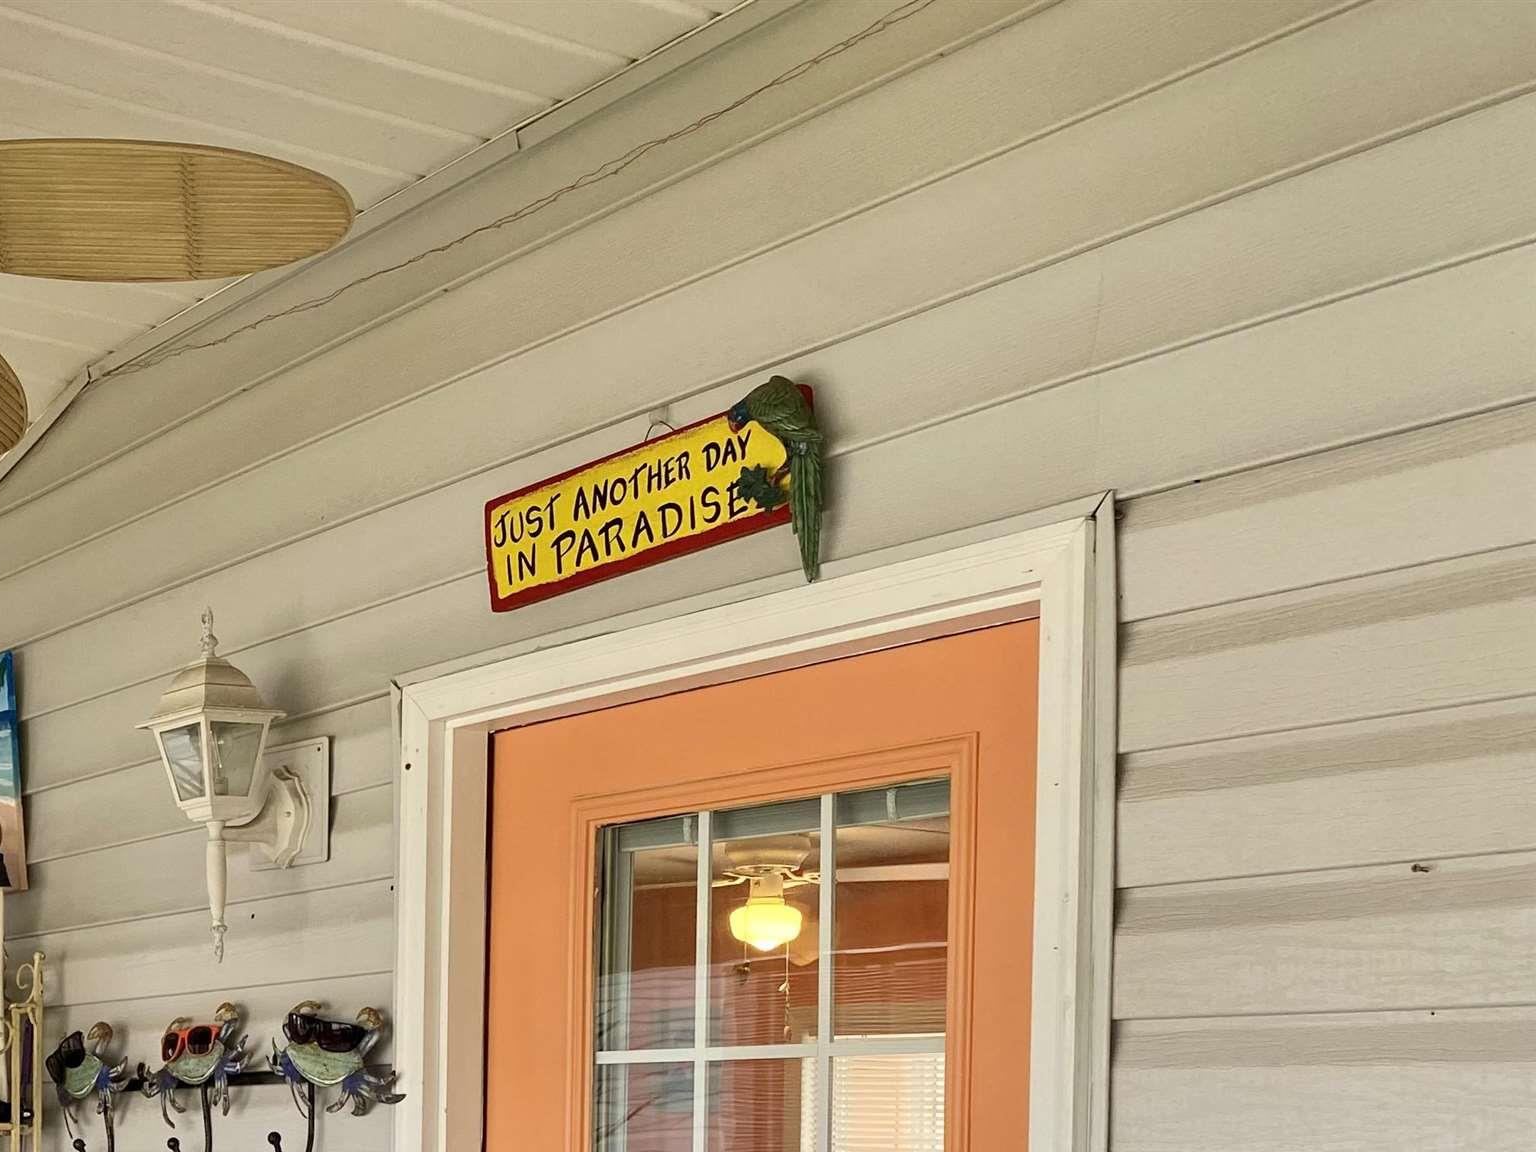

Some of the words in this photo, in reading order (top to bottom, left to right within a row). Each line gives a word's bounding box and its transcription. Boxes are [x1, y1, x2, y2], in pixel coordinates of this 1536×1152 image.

[494, 493, 561, 549] JUST
[573, 451, 690, 523] ANOTHER
[702, 429, 752, 473] DAY
[506, 543, 536, 586] IN
[551, 480, 749, 576] PARADISE
